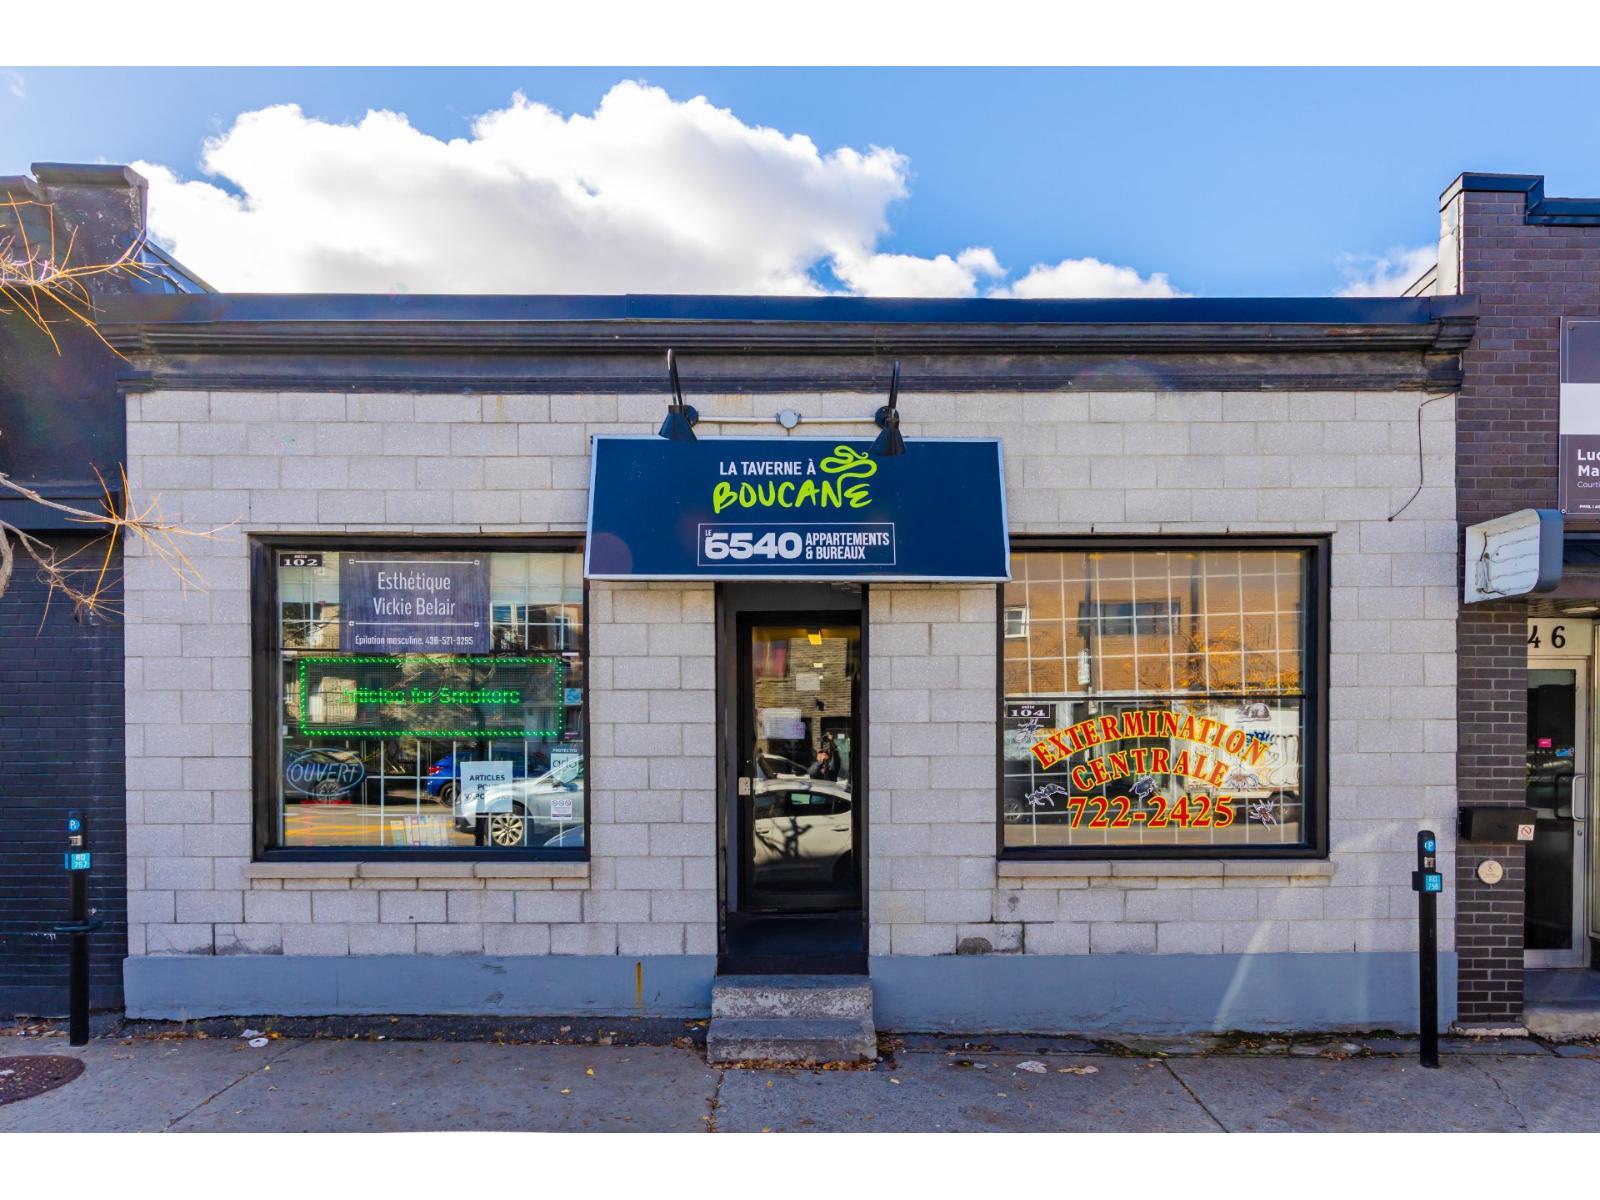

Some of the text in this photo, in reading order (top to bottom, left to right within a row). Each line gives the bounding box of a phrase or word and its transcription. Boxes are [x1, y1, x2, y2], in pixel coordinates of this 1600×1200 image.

[719, 458, 816, 476] LA TAVERNE À
[712, 445, 878, 514] BOUCANE
[705, 529, 713, 537] LE
[805, 532, 890, 546] APPARTEMENTS
[704, 531, 803, 560] 6540
[805, 546, 866, 560] & BUREAUX
[283, 558, 318, 566] 102
[377, 570, 451, 594] Esthétique
[373, 597, 456, 615] Vickie Belair
[411, 687, 434, 703] for
[1010, 709, 1046, 717] 104
[1031, 710, 1269, 770] EXTERMINATION
[290, 762, 360, 783] OUVERT
[469, 774, 506, 782] ARTICLES
[1071, 747, 1230, 792] CENTRALE
[1066, 795, 1235, 830] 722-2425
